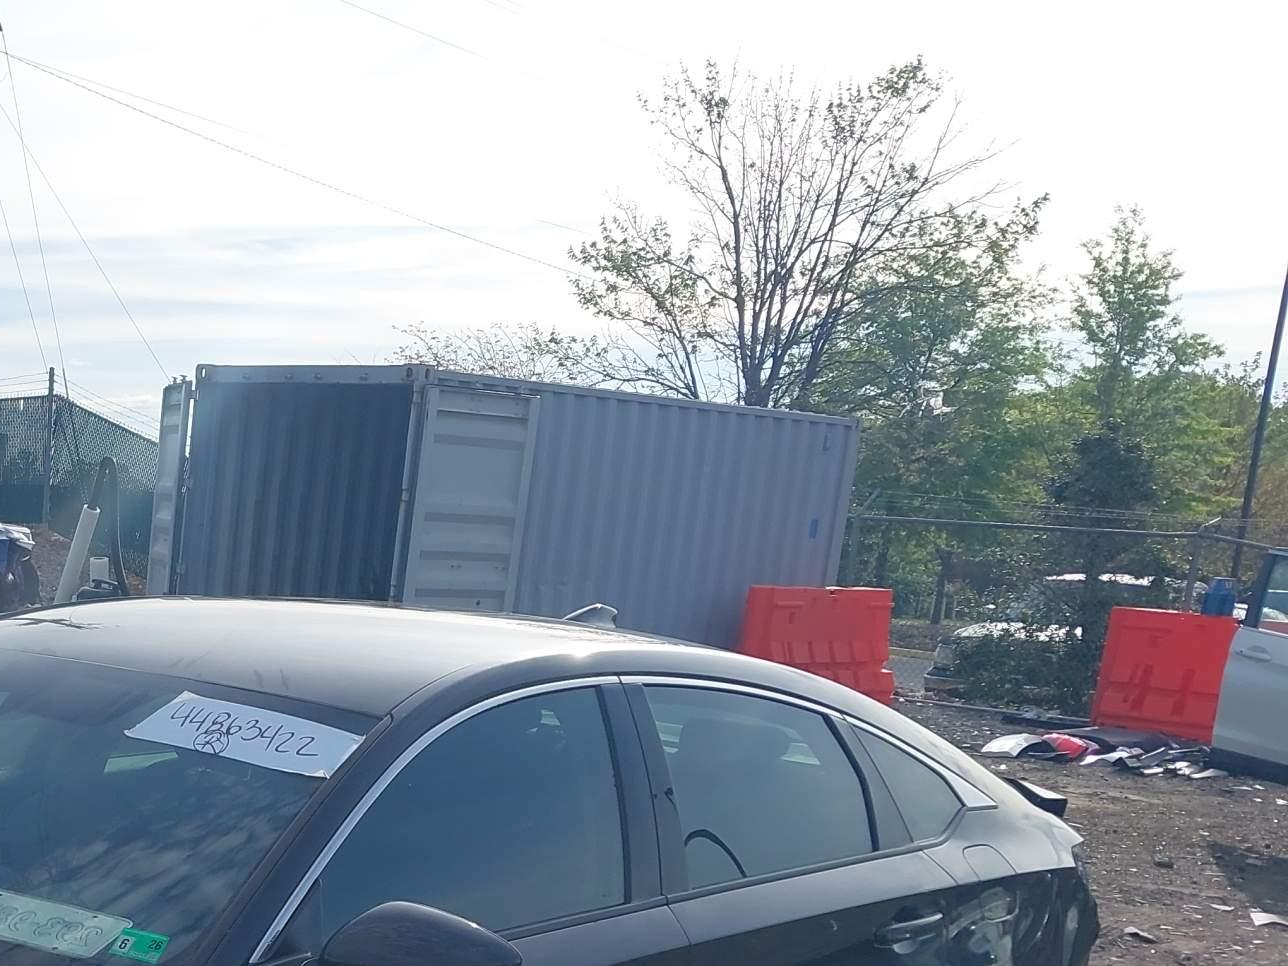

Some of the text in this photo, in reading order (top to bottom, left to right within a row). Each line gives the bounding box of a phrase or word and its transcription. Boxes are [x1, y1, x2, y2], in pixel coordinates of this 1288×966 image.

[170, 702, 320, 757] 44863422
[118, 938, 164, 951] 6 26
